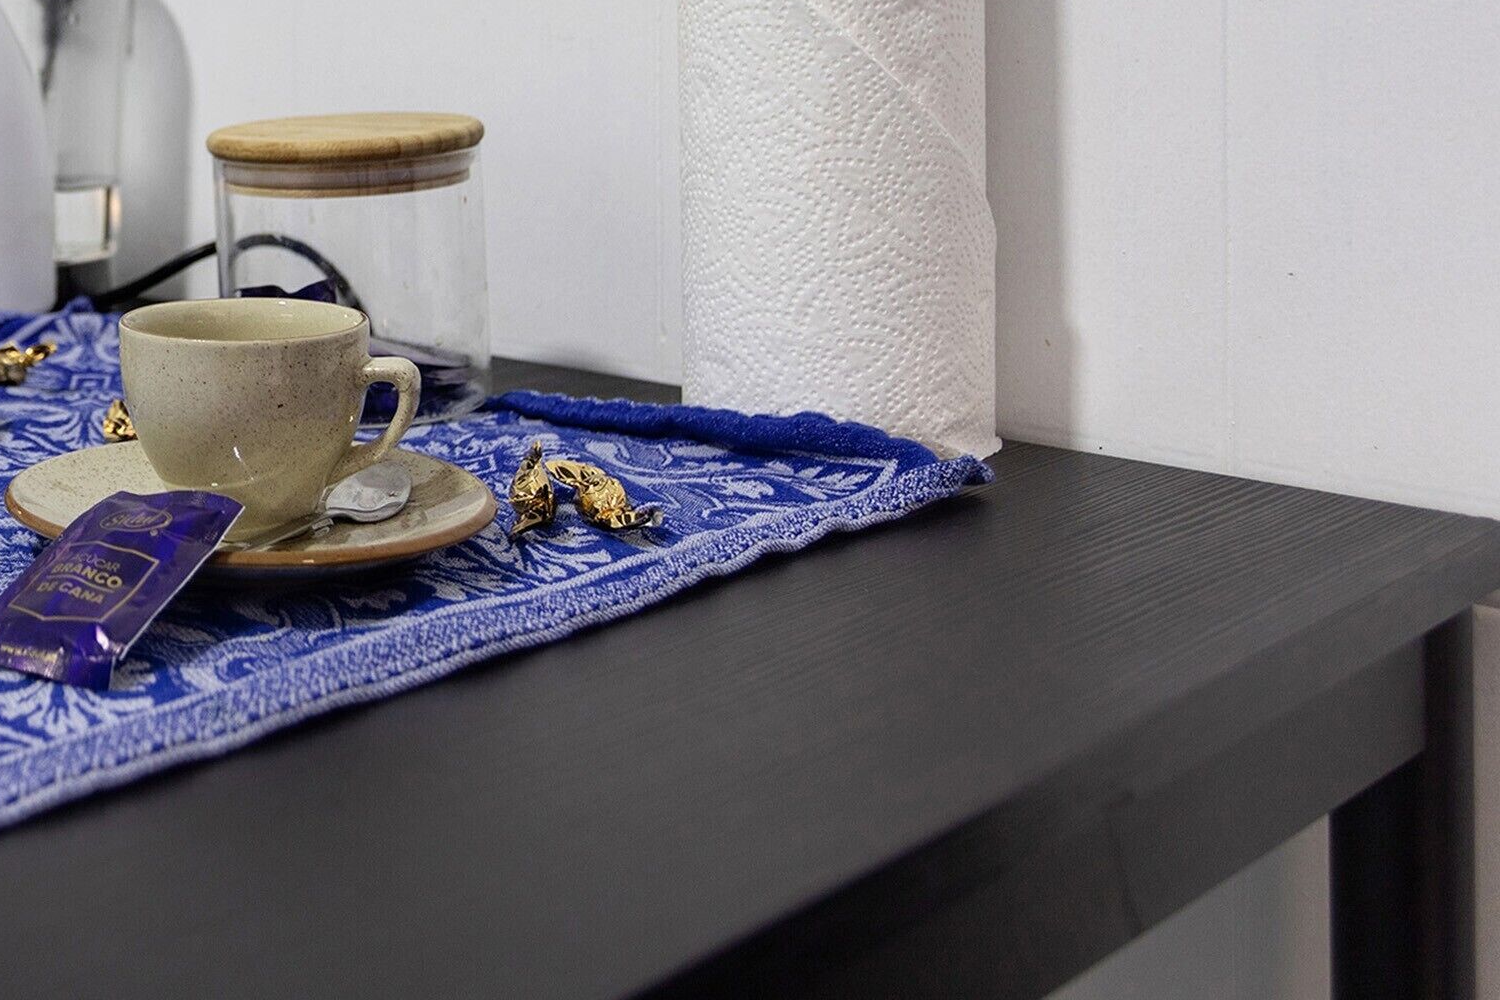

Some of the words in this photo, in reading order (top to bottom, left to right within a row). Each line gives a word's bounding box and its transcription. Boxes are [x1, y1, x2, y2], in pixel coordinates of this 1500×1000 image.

[51, 562, 122, 588] BRANCO
[37, 581, 58, 592] DE
[59, 582, 104, 604] CANA
